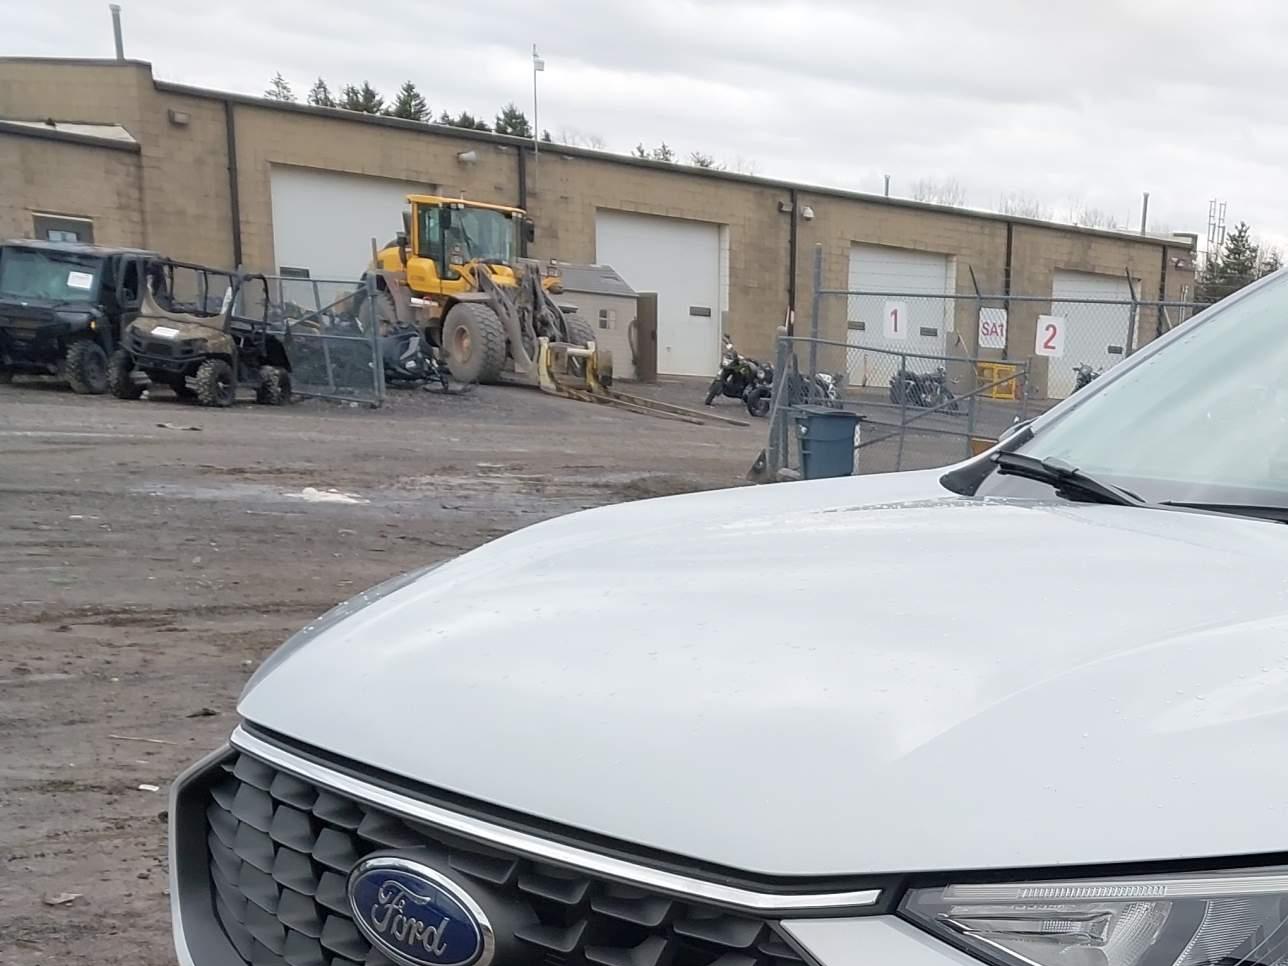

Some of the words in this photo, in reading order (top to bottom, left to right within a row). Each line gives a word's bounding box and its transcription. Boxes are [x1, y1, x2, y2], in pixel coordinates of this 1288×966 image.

[889, 308, 899, 333] 1
[1043, 323, 1058, 350] 2
[371, 880, 451, 957] Ford
